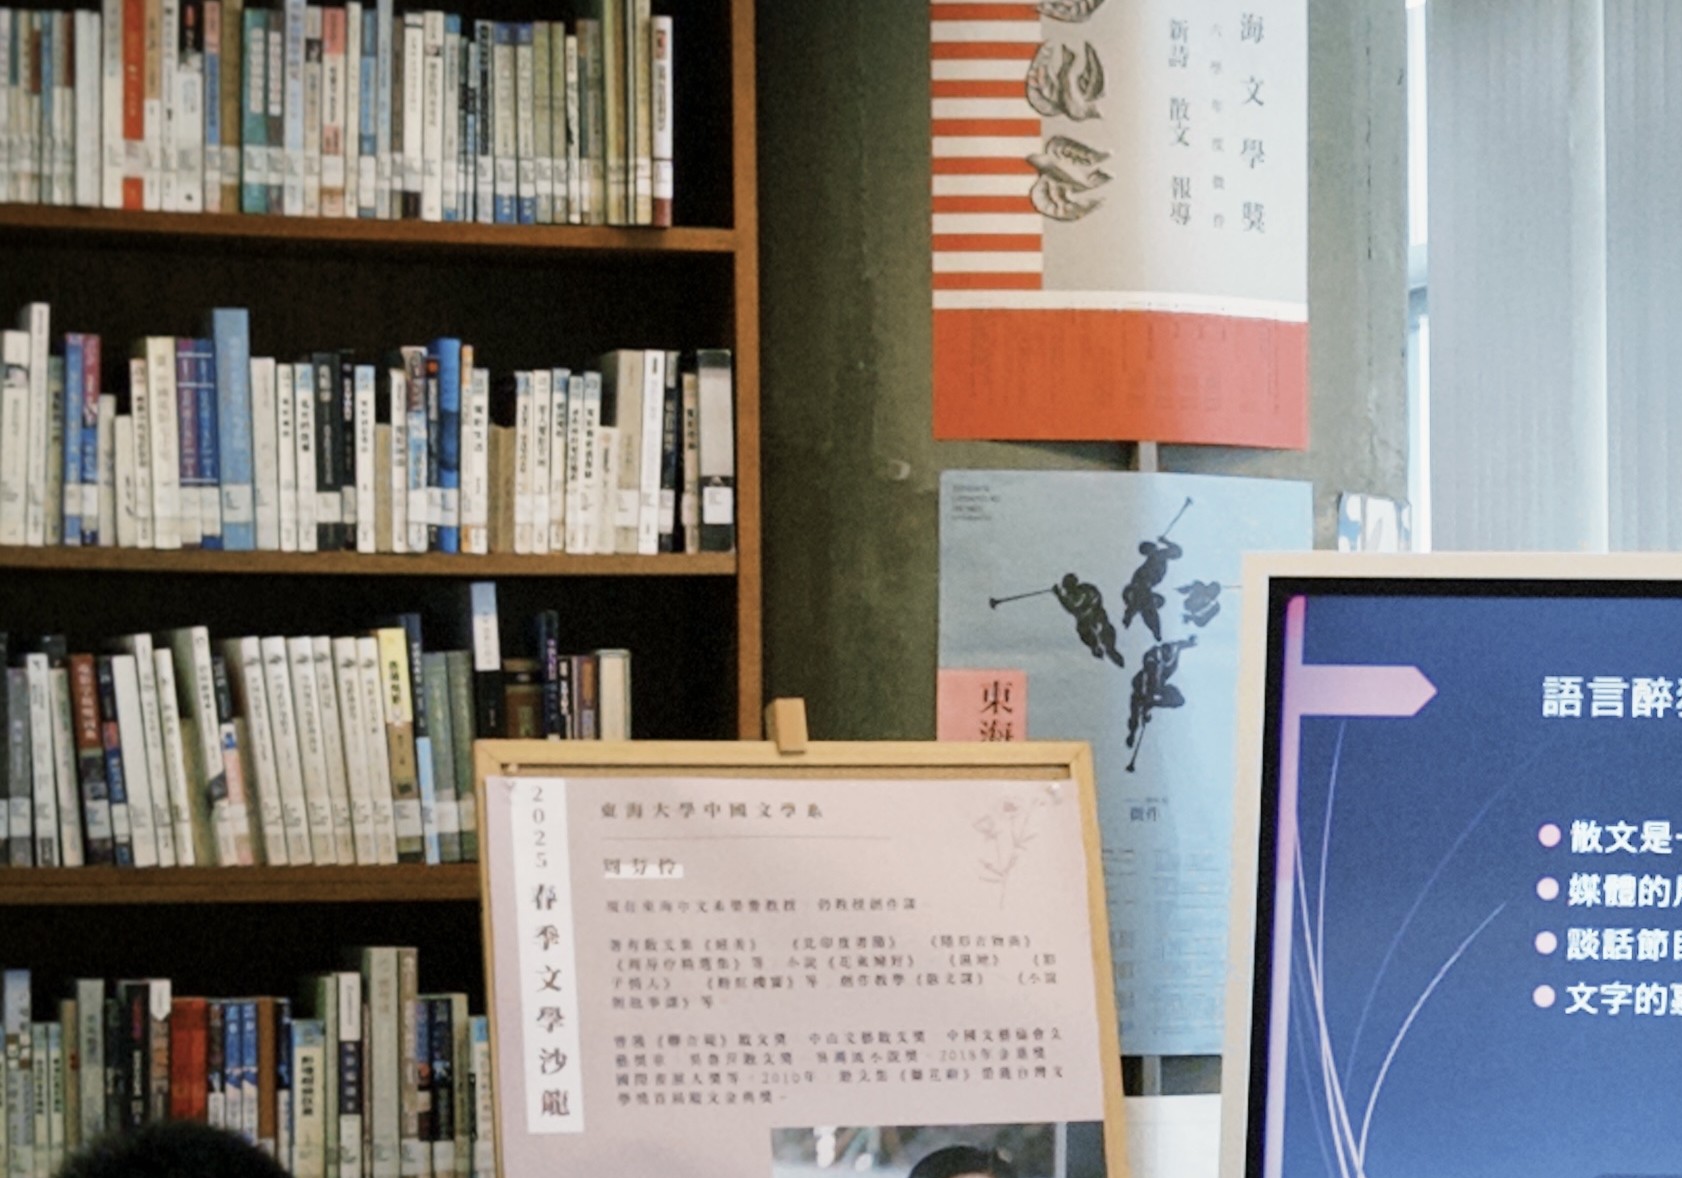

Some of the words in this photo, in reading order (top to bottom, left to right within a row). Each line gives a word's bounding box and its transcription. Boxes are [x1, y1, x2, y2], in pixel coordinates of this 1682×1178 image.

[1168, 19, 1189, 68] 新詩
[1169, 97, 1190, 146] 散文
[1240, 13, 1265, 233] 海文學獎
[1170, 175, 1191, 226] 報導
[601, 801, 823, 819] 東海大學中國文學系
